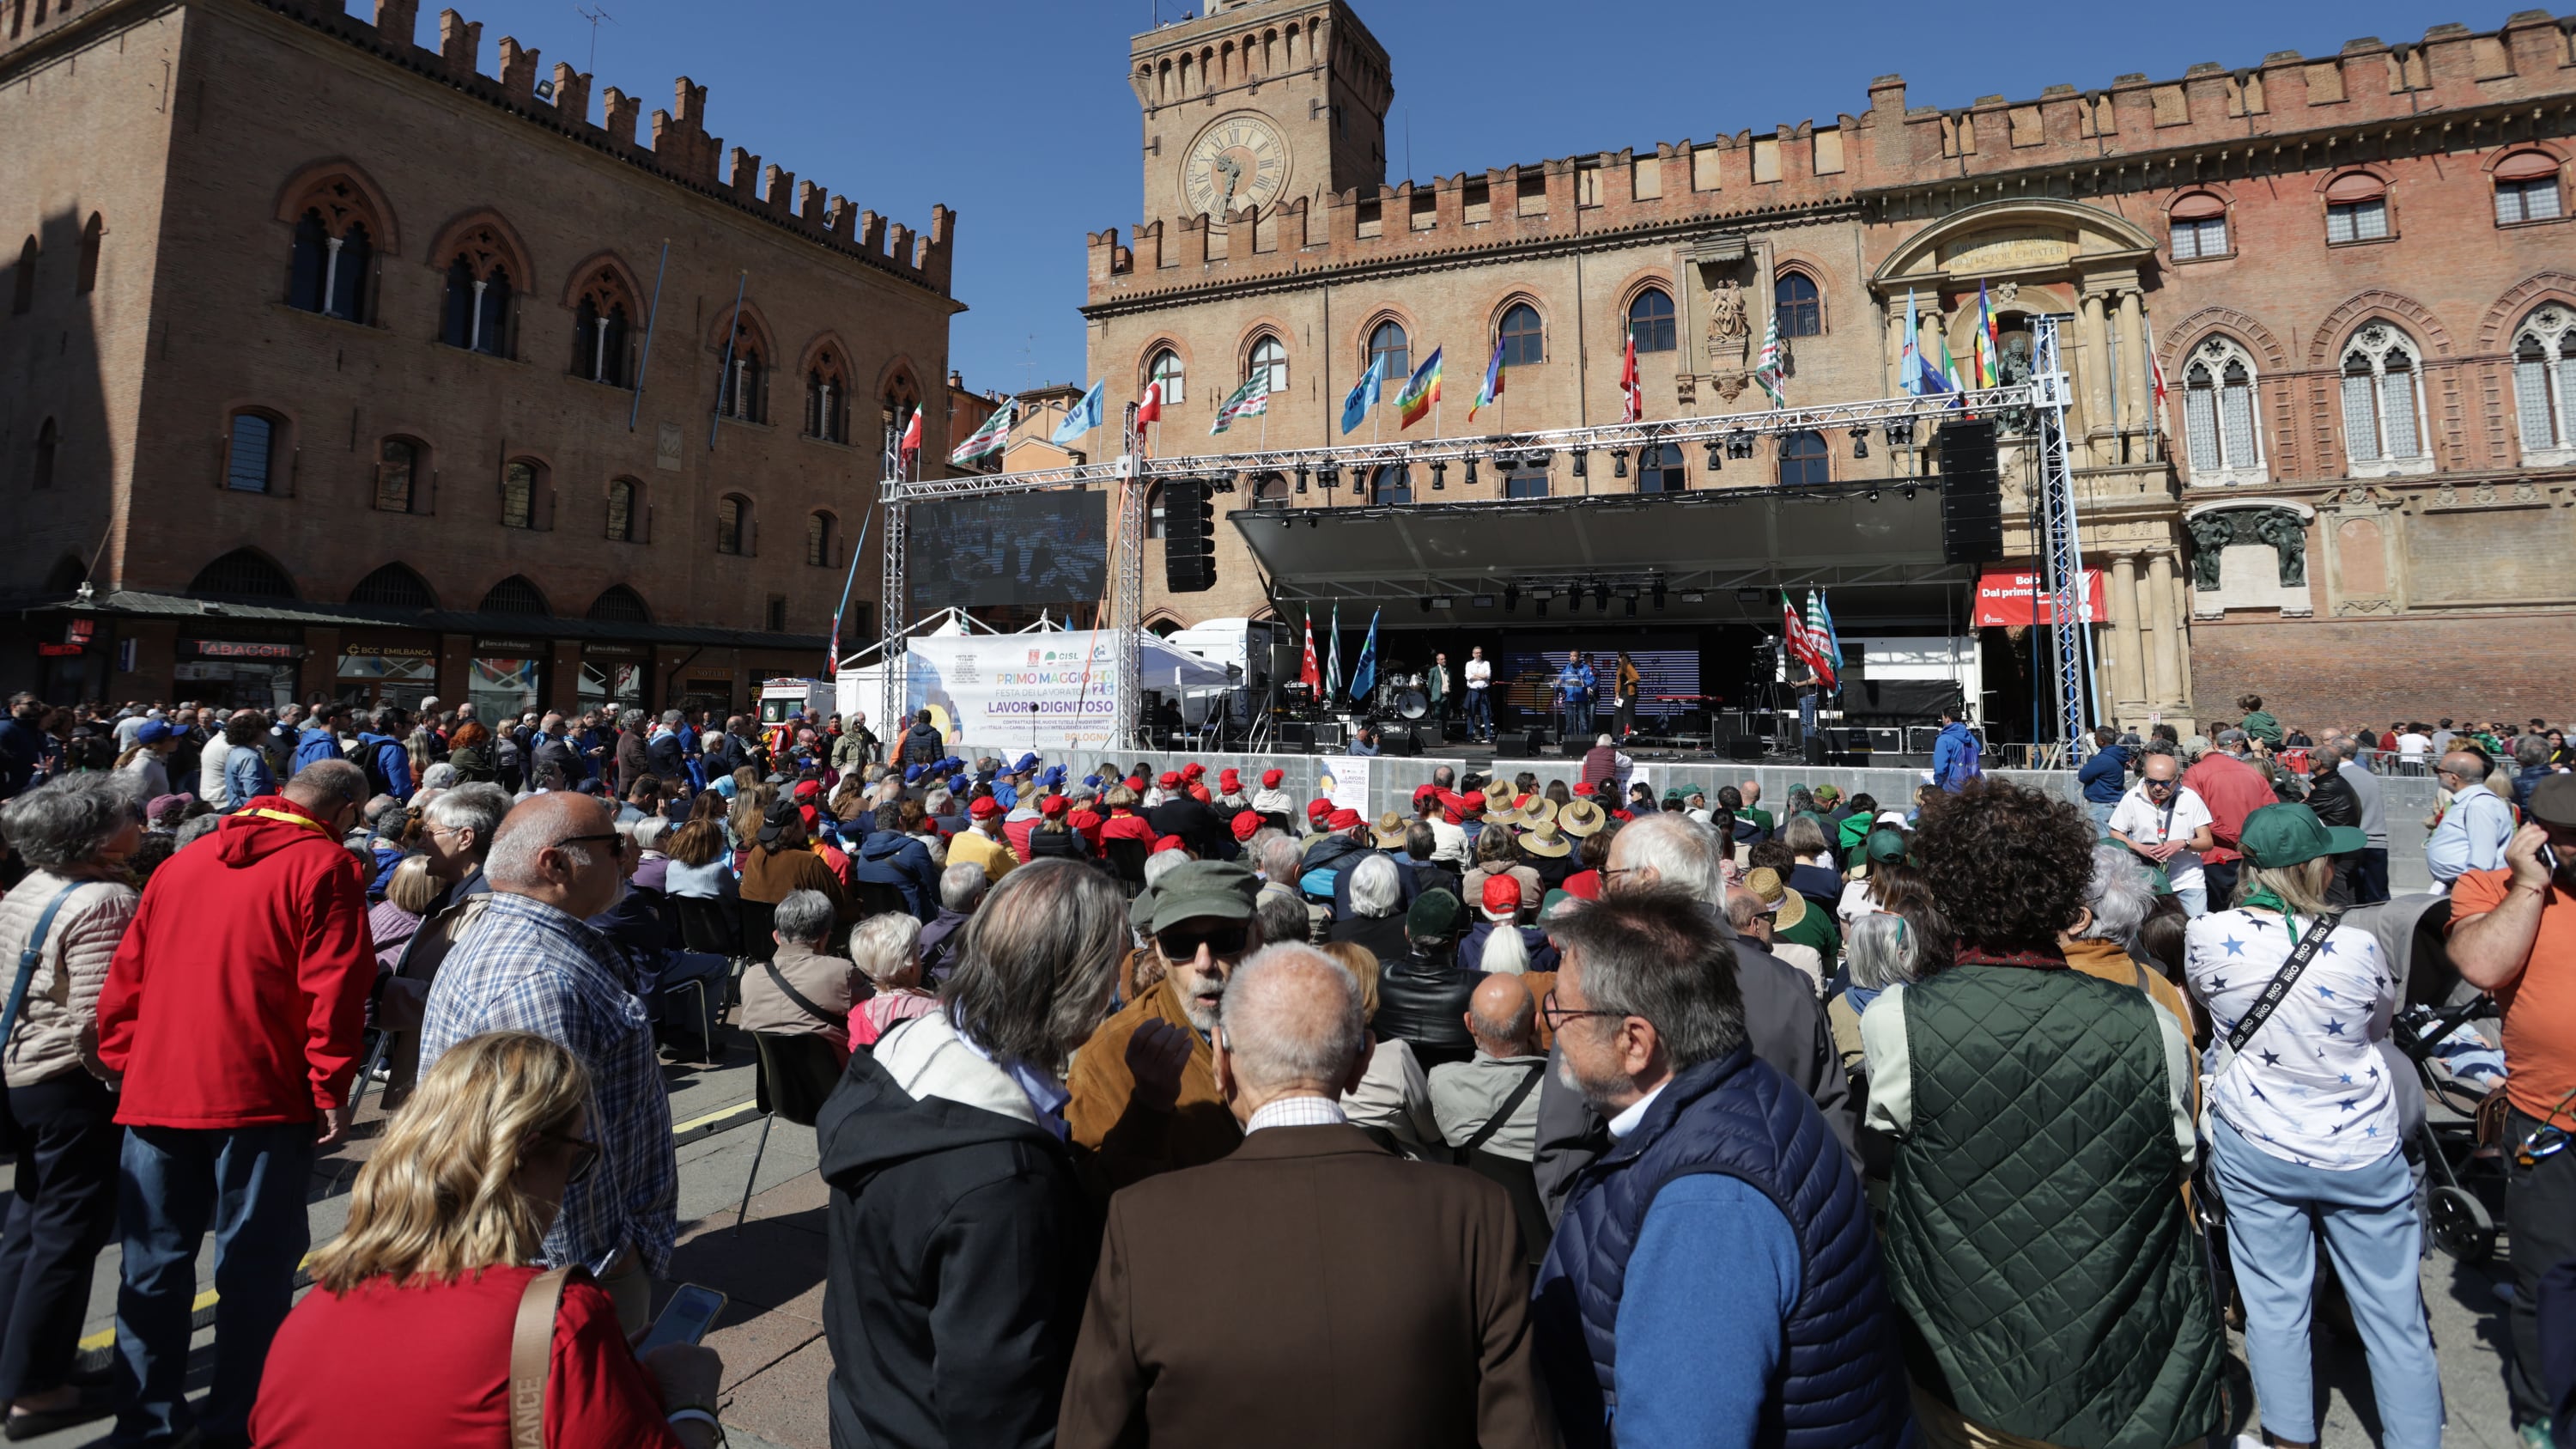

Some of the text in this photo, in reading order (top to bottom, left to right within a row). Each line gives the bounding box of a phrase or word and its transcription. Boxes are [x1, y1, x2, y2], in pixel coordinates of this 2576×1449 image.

[2029, 246, 2063, 258] PATER
[1982, 588, 2000, 597] Dal
[193, 640, 291, 657] TABACCHI
[997, 673, 1037, 684] PRIMO
[1039, 672, 1091, 684] MAGGIO
[996, 689, 1020, 697] FESTA
[1037, 688, 1091, 697] LAVORATORI
[1041, 701, 1114, 713] DIGNITOSO
[1065, 733, 1109, 741] BOLOGNA
[2312, 927, 2328, 943] RKO
[2295, 944, 2310, 960] RKO
[2284, 965, 2299, 982] RKO
[2266, 983, 2282, 1000] RKO
[2255, 1003, 2270, 1019] RKO
[2240, 1018, 2253, 1032] RKO
[516, 1376, 541, 1449] ANCE
